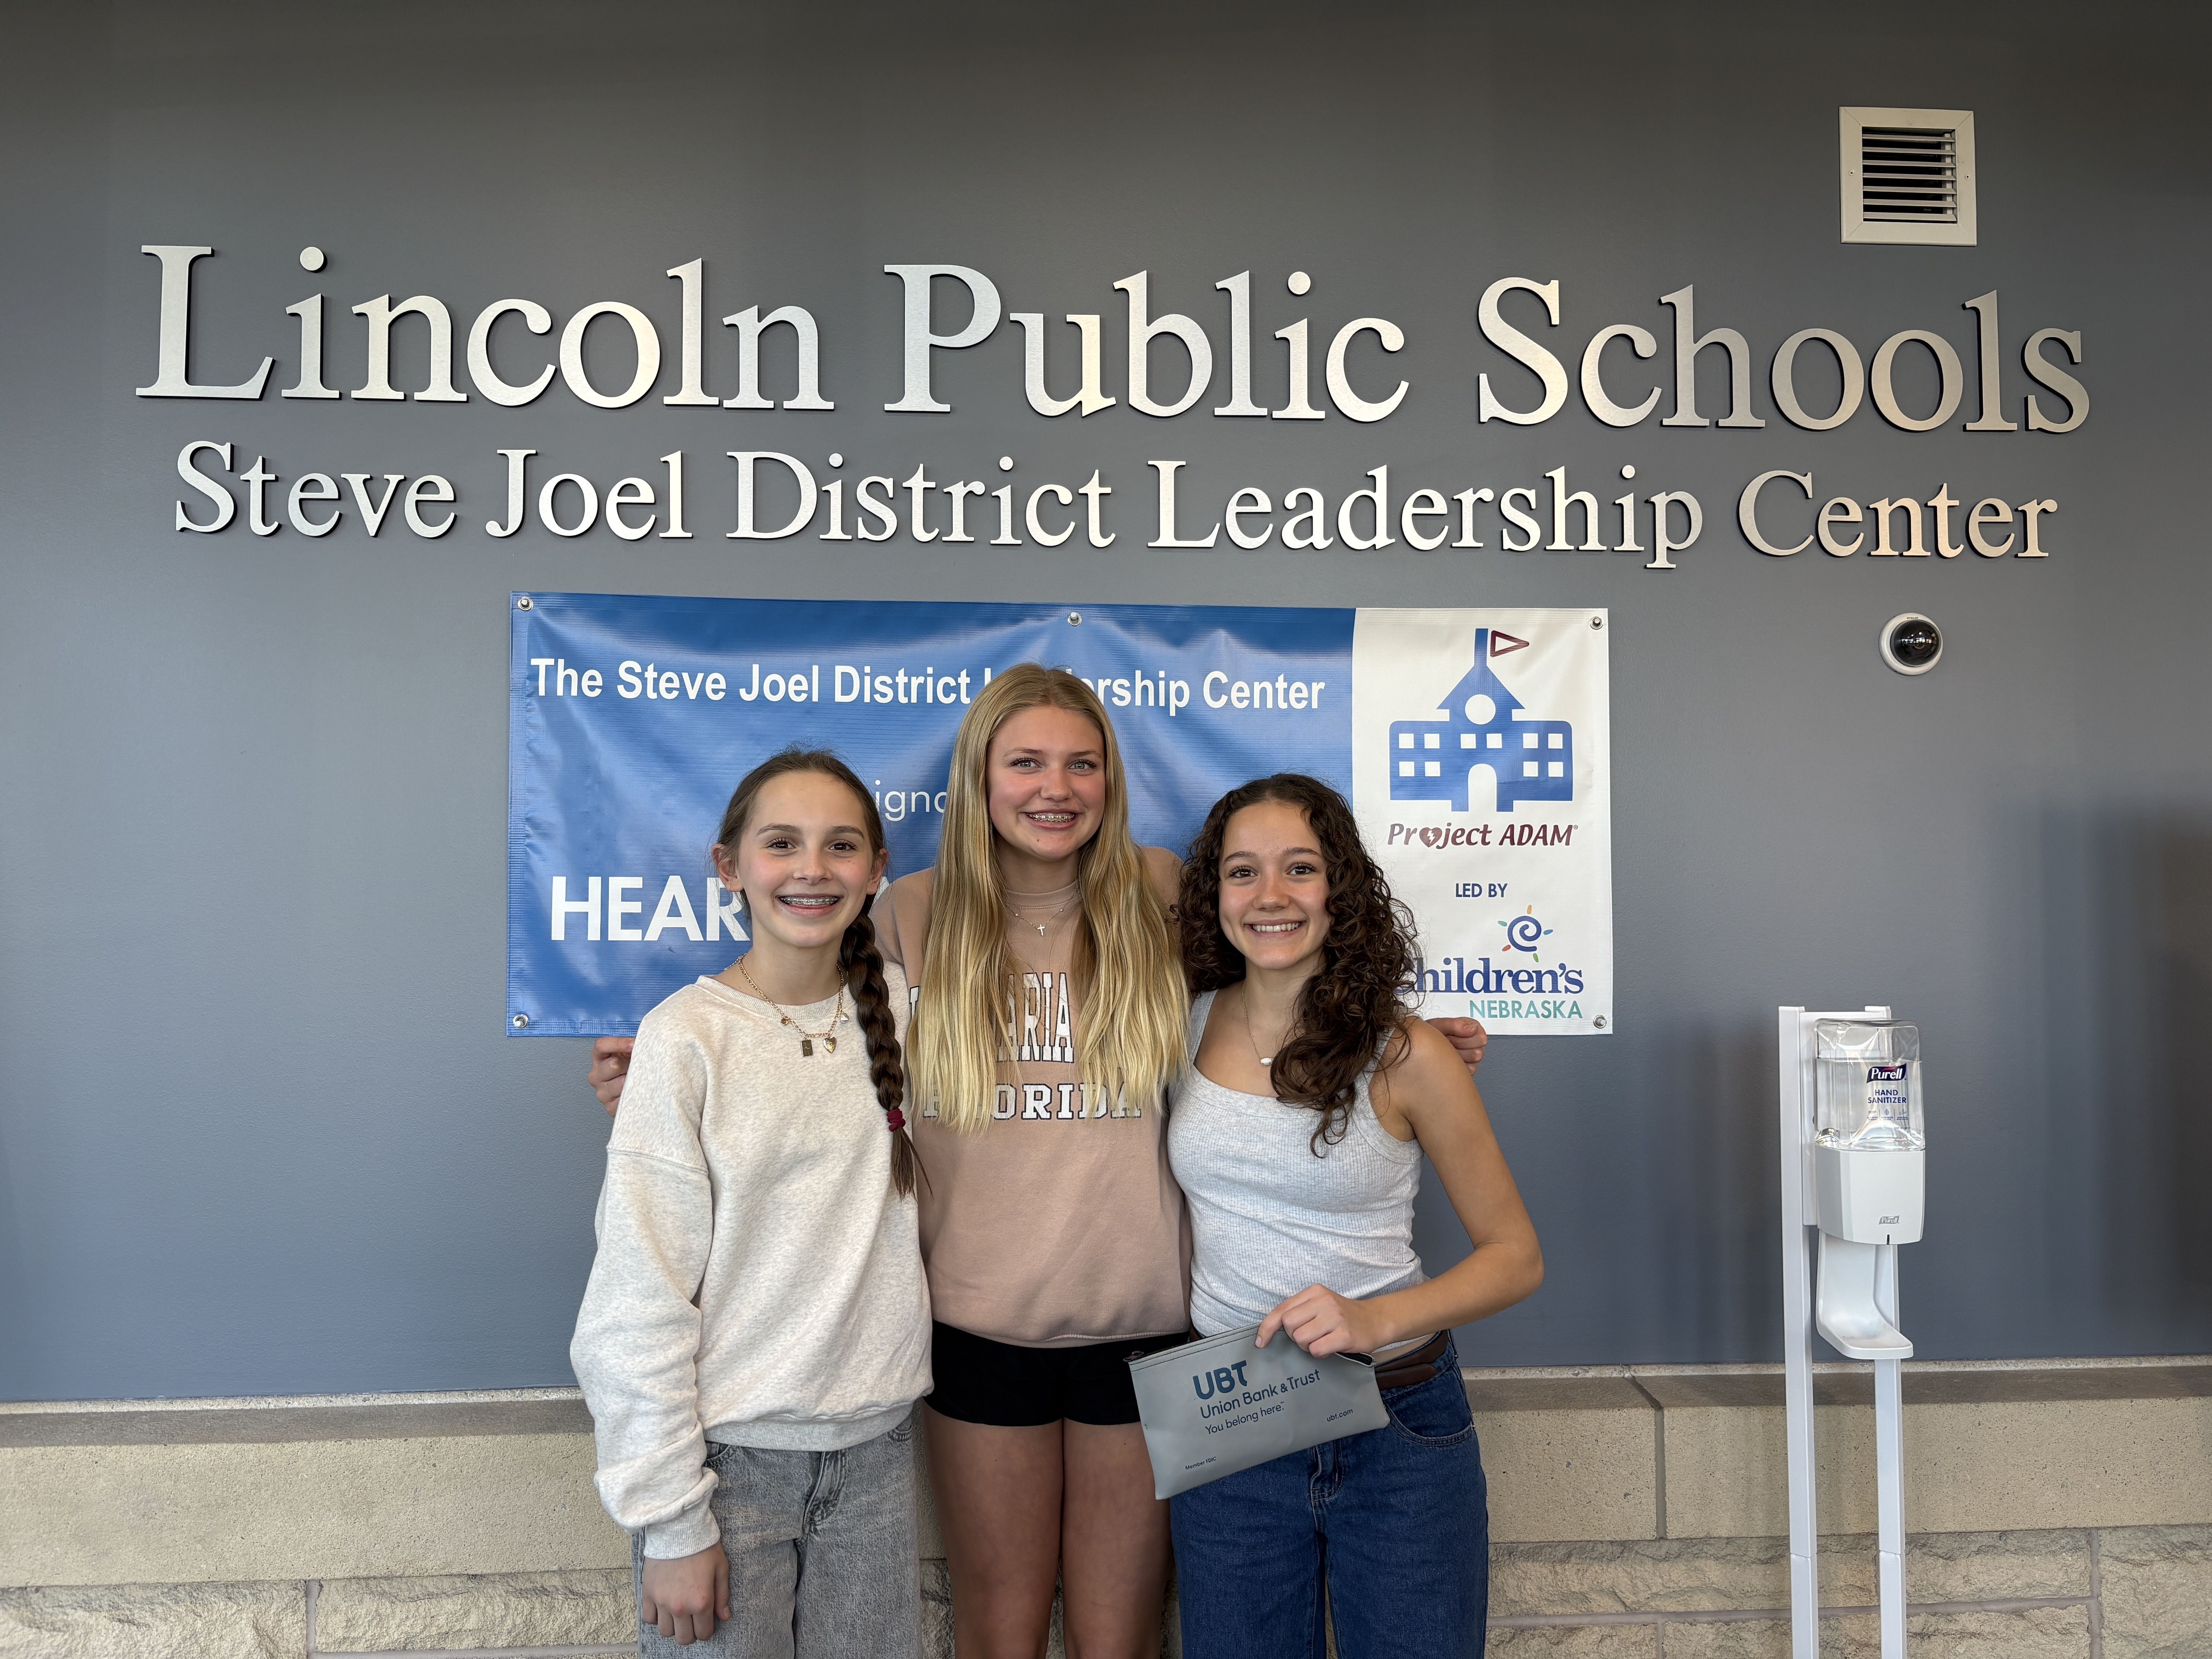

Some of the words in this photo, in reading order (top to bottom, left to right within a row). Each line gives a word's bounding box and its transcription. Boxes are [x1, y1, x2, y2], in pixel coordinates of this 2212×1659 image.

[136, 245, 835, 411] Lincoln
[884, 264, 1409, 422] Public
[1477, 276, 2090, 433] Schools
[175, 440, 457, 538] Steve
[485, 448, 693, 541] Joel
[725, 451, 1116, 548] District
[1147, 460, 1703, 568] Leadership
[1738, 470, 2057, 558] Center
[531, 658, 603, 697] The
[617, 660, 727, 700] Steve
[739, 663, 819, 702] Joel
[835, 665, 971, 704] District
[1203, 670, 1325, 709] Center
[550, 875, 750, 941] HEAR
[1455, 883, 1482, 897] LED
[1488, 883, 1508, 897] BY
[994, 972, 1075, 1063] ARIA
[1469, 1000, 1583, 1018] NEBRASKA
[1871, 1068, 1903, 1079] Purell
[1193, 1360, 1248, 1400] UBT
[1200, 1398, 1240, 1419] Union
[1242, 1384, 1279, 1405] Bank
[1280, 1383, 1288, 1393] &
[1286, 1369, 1321, 1390] Trust
[1205, 1424, 1224, 1434] You
[1225, 1412, 1259, 1429] belong
[1327, 1408, 1353, 1422] ubt.com
[1185, 1461, 1205, 1470] Member
